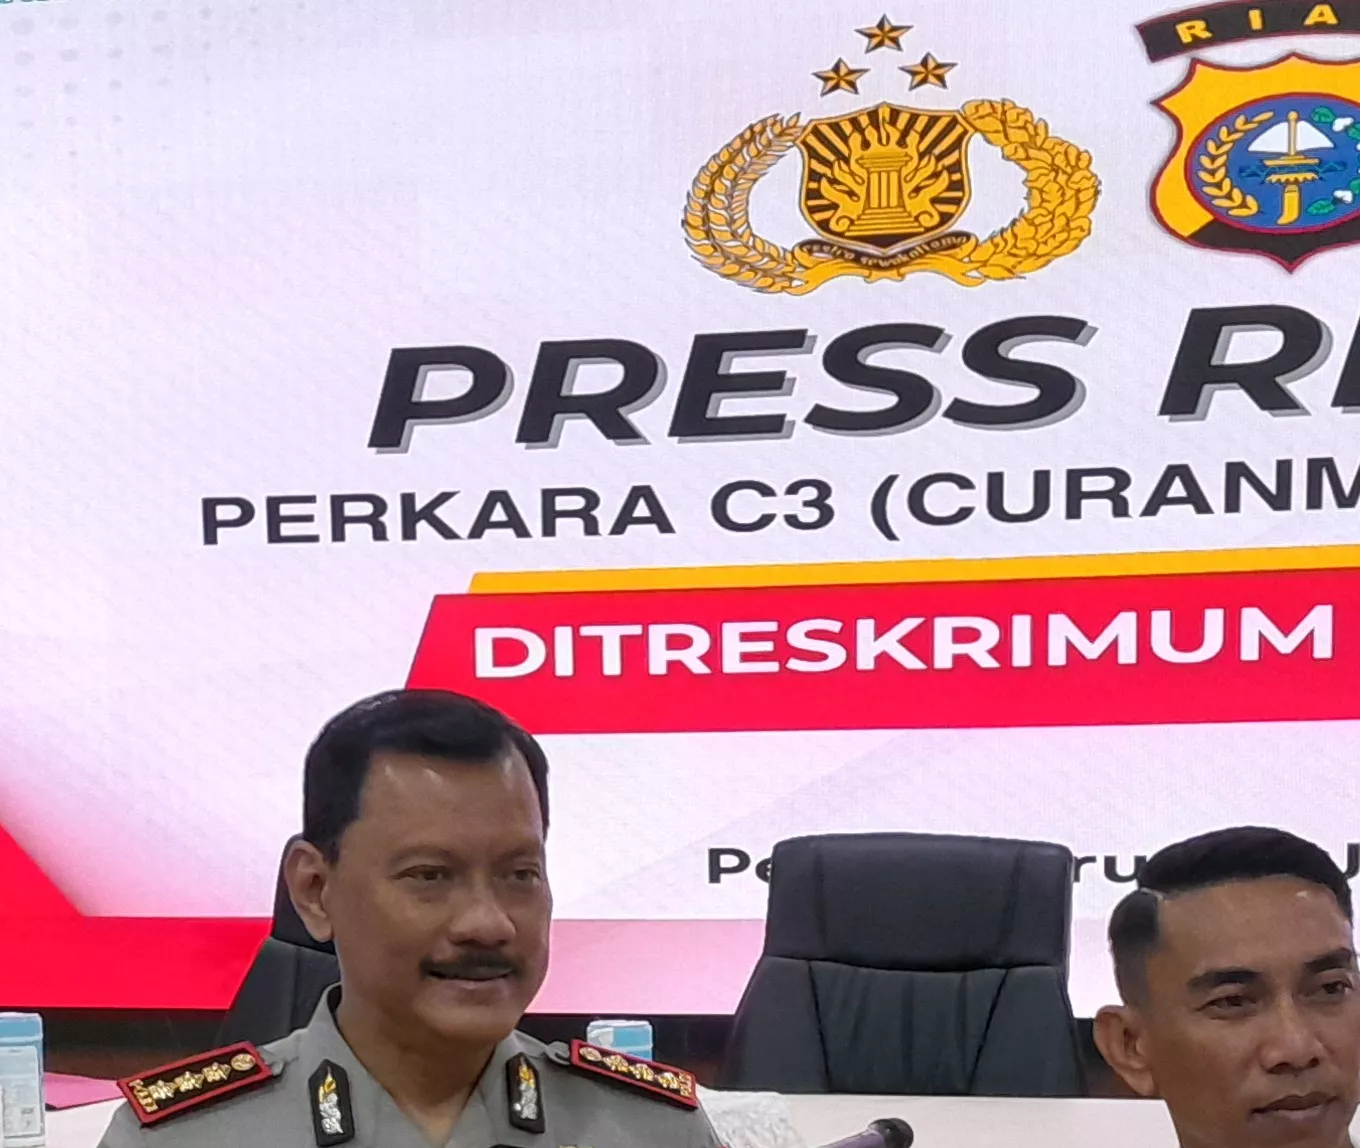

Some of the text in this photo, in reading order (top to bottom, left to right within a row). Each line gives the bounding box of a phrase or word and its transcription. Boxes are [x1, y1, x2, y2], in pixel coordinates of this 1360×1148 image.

[368, 316, 1093, 452] PRESS
[202, 486, 675, 545] PERKARA
[711, 479, 834, 533] C3
[475, 604, 1333, 678] DITRESKRIMUM
